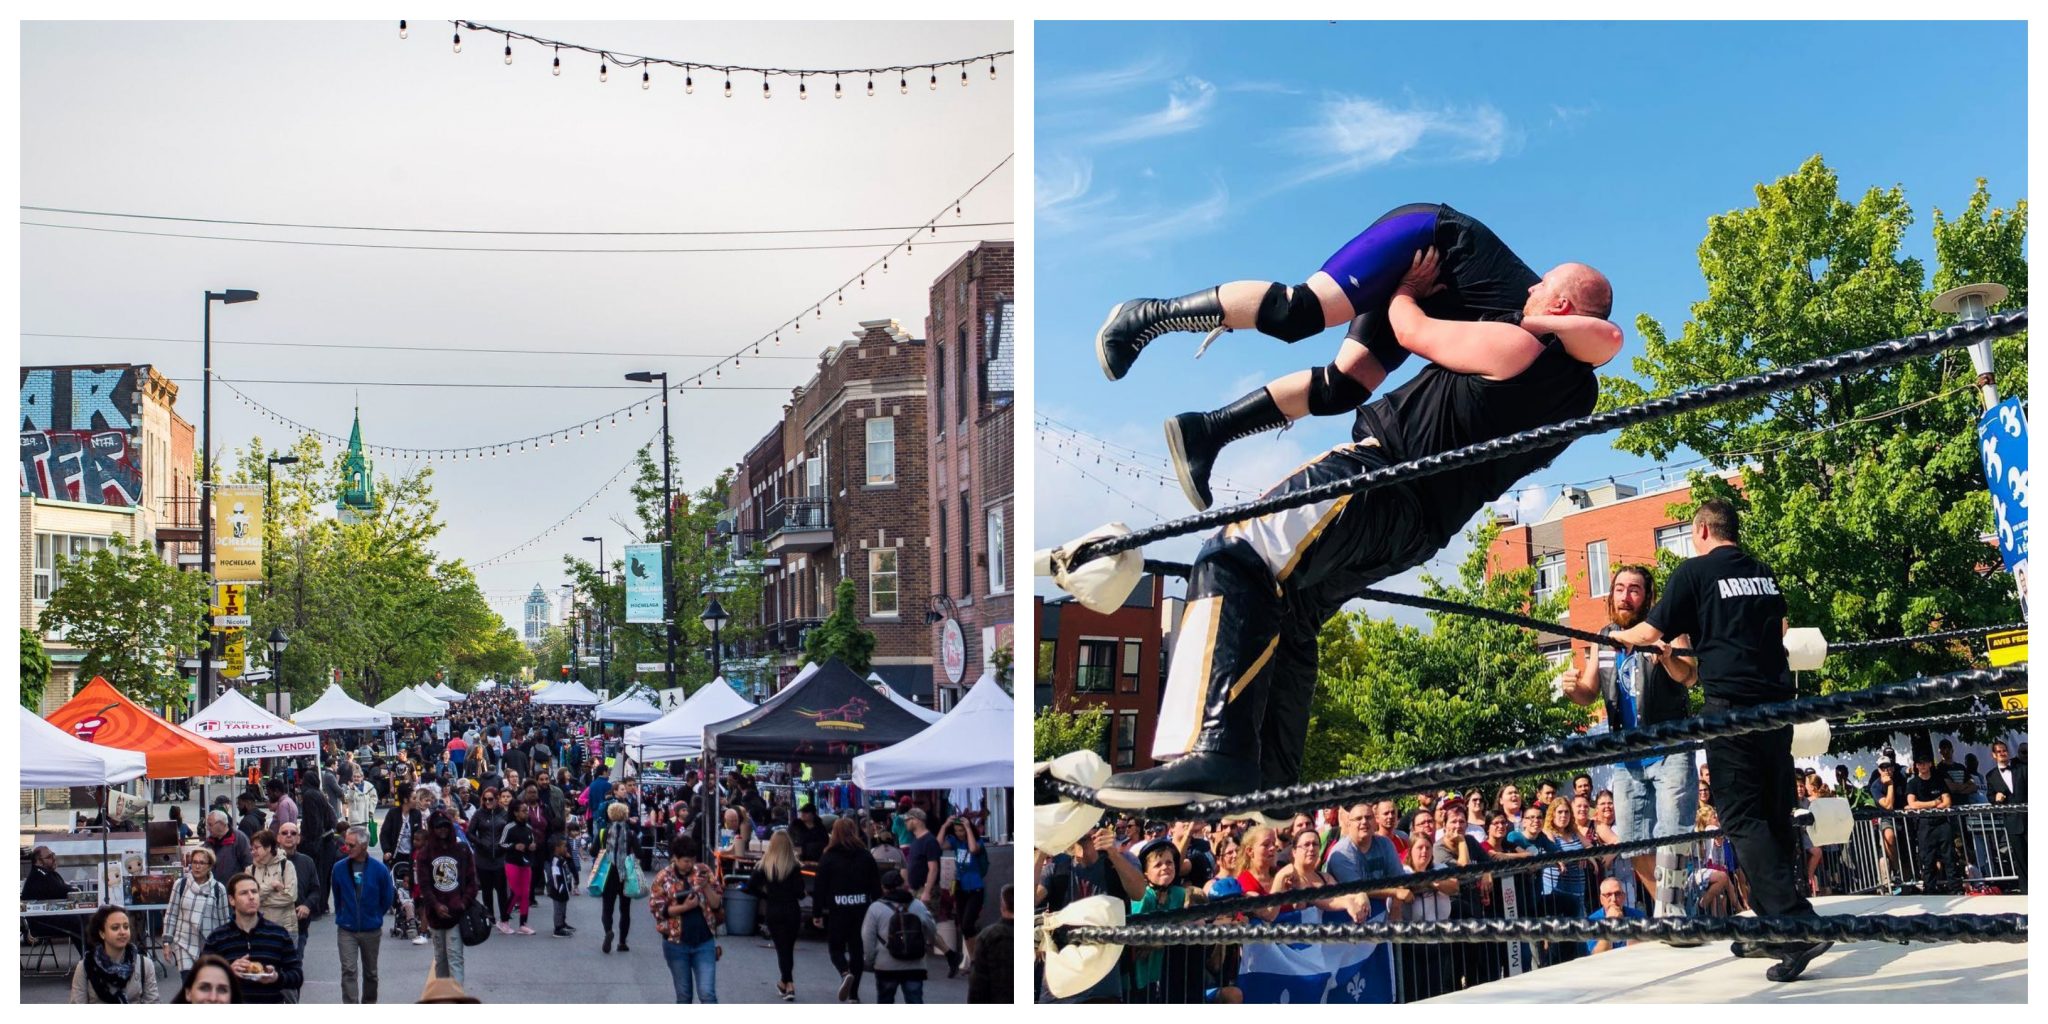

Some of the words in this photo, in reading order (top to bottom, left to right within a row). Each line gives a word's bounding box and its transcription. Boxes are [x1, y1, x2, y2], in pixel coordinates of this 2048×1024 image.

[220, 559, 256, 567] HOCHELAGA
[1718, 577, 1779, 599] ARBITRE
[1993, 637, 2010, 646] AVIS
[277, 741, 315, 752] VENDU!
[834, 893, 867, 905] VOGUE
